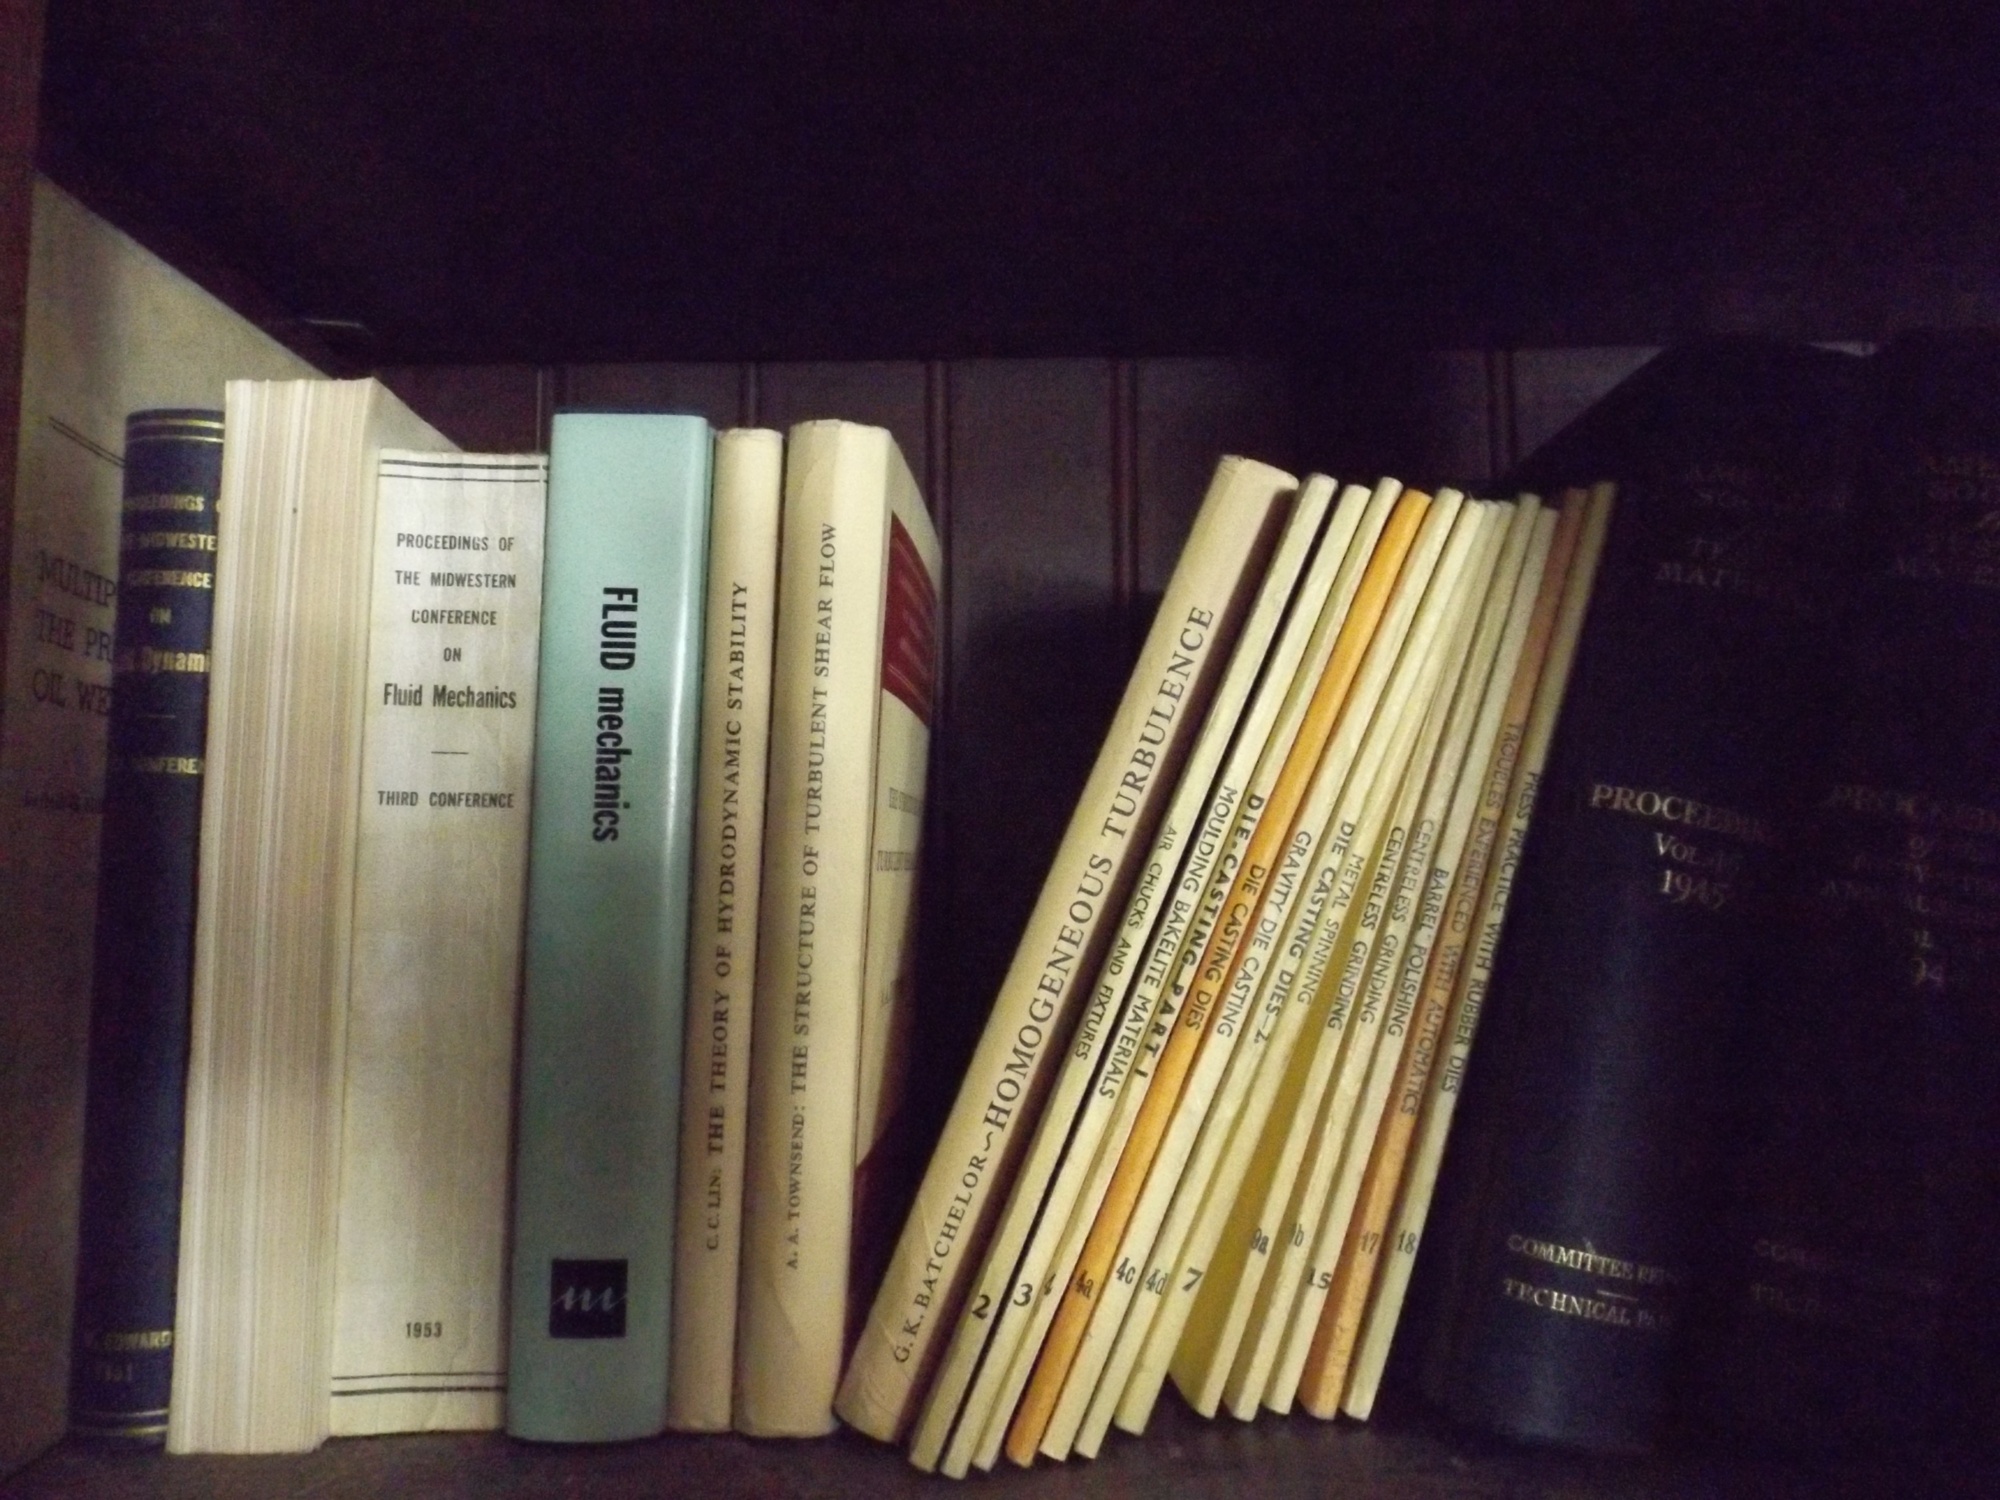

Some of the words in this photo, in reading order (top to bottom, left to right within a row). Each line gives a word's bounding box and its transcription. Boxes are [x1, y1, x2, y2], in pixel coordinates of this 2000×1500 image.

[396, 533, 489, 551] PROCEEDINGS
[498, 537, 515, 551] OF
[819, 523, 838, 588] FLOW
[395, 570, 421, 586] THE
[430, 572, 517, 588] MIDWESTERN
[37, 608, 75, 652] THE
[411, 609, 497, 625] CONFERENCE
[600, 587, 638, 671] FLUID
[813, 598, 834, 678] SHEAR
[443, 647, 462, 662] ON
[727, 582, 748, 711] STABILITY
[32, 668, 66, 709] OIL
[383, 683, 423, 707] Fluid
[433, 685, 517, 709] Mechanics
[592, 687, 633, 842] mechanics
[805, 687, 828, 836] TURBULENT
[377, 790, 418, 807] THIRD
[429, 792, 515, 809] CONFERENCE
[1515, 771, 1541, 821] PRESS
[718, 720, 742, 933] HYDRODYNAMIC
[1159, 823, 1178, 852] AIR
[1182, 785, 1238, 893] MOULDING
[1331, 820, 1356, 856] DIE
[803, 845, 819, 878] OF
[1241, 863, 1266, 896] DIE
[1268, 830, 1313, 914] GRAVITY
[1331, 853, 1366, 909] METAL
[1360, 826, 1406, 931] CENTRELESS
[1391, 819, 1435, 924] CENTRELESS
[1451, 816, 1497, 934] EXPERIENCED
[1491, 827, 1527, 914] PRACTICE
[1128, 862, 1163, 929] CHUCKS
[1289, 866, 1337, 960] CASTING
[1418, 868, 1450, 931] BARREL
[914, 1154, 988, 1310] BATCHELOR
[983, 853, 1114, 1133] HOMOGENEOUS
[1101, 607, 1215, 843] TURBULENCE
[1108, 937, 1132, 976] AND
[1143, 899, 1192, 989] BAKELITE
[1204, 902, 1249, 984] CASTING
[1252, 917, 1278, 951] DIE
[1477, 922, 1502, 970] WITH
[714, 944, 733, 979] OF
[795, 886, 818, 1036] STRUCTURE
[1297, 918, 1340, 1007] SPINNING
[1327, 941, 1368, 1032] GRINDING
[1360, 934, 1399, 1025] GRINDING
[1434, 944, 1462, 992] WITH
[1185, 991, 1212, 1032] DIES
[1217, 956, 1260, 1038] CASTING
[1387, 945, 1427, 1038] POLISHING
[1454, 979, 1485, 1047] RUBBER
[710, 989, 731, 1094] THEORY
[1075, 984, 1114, 1061] FIXTURES
[1143, 981, 1186, 1059] PART
[791, 1044, 809, 1095] THE
[1098, 993, 1154, 1100] MATERIALS
[1401, 998, 1445, 1118] AUTOMATICS
[1441, 1055, 1466, 1094] DIES
[707, 1105, 725, 1156] THE
[788, 1105, 806, 1220] TOWNSEND:
[785, 1251, 798, 1271] A.
[786, 1227, 800, 1246] A.
[1361, 1230, 1381, 1255] 17
[1397, 1229, 1417, 1255] 18
[1506, 1233, 1635, 1281] COMMITTEE
[1013, 1283, 1034, 1307] 3
[1075, 1270, 1095, 1300] 4a
[1115, 1257, 1136, 1286] 4c
[1145, 1268, 1169, 1297] 4d
[1182, 1266, 1204, 1293] 7
[1306, 1267, 1333, 1290] 15
[971, 1294, 992, 1320] 2
[1503, 1276, 1632, 1328] TECHNICAL
[405, 1321, 443, 1338] 1953
